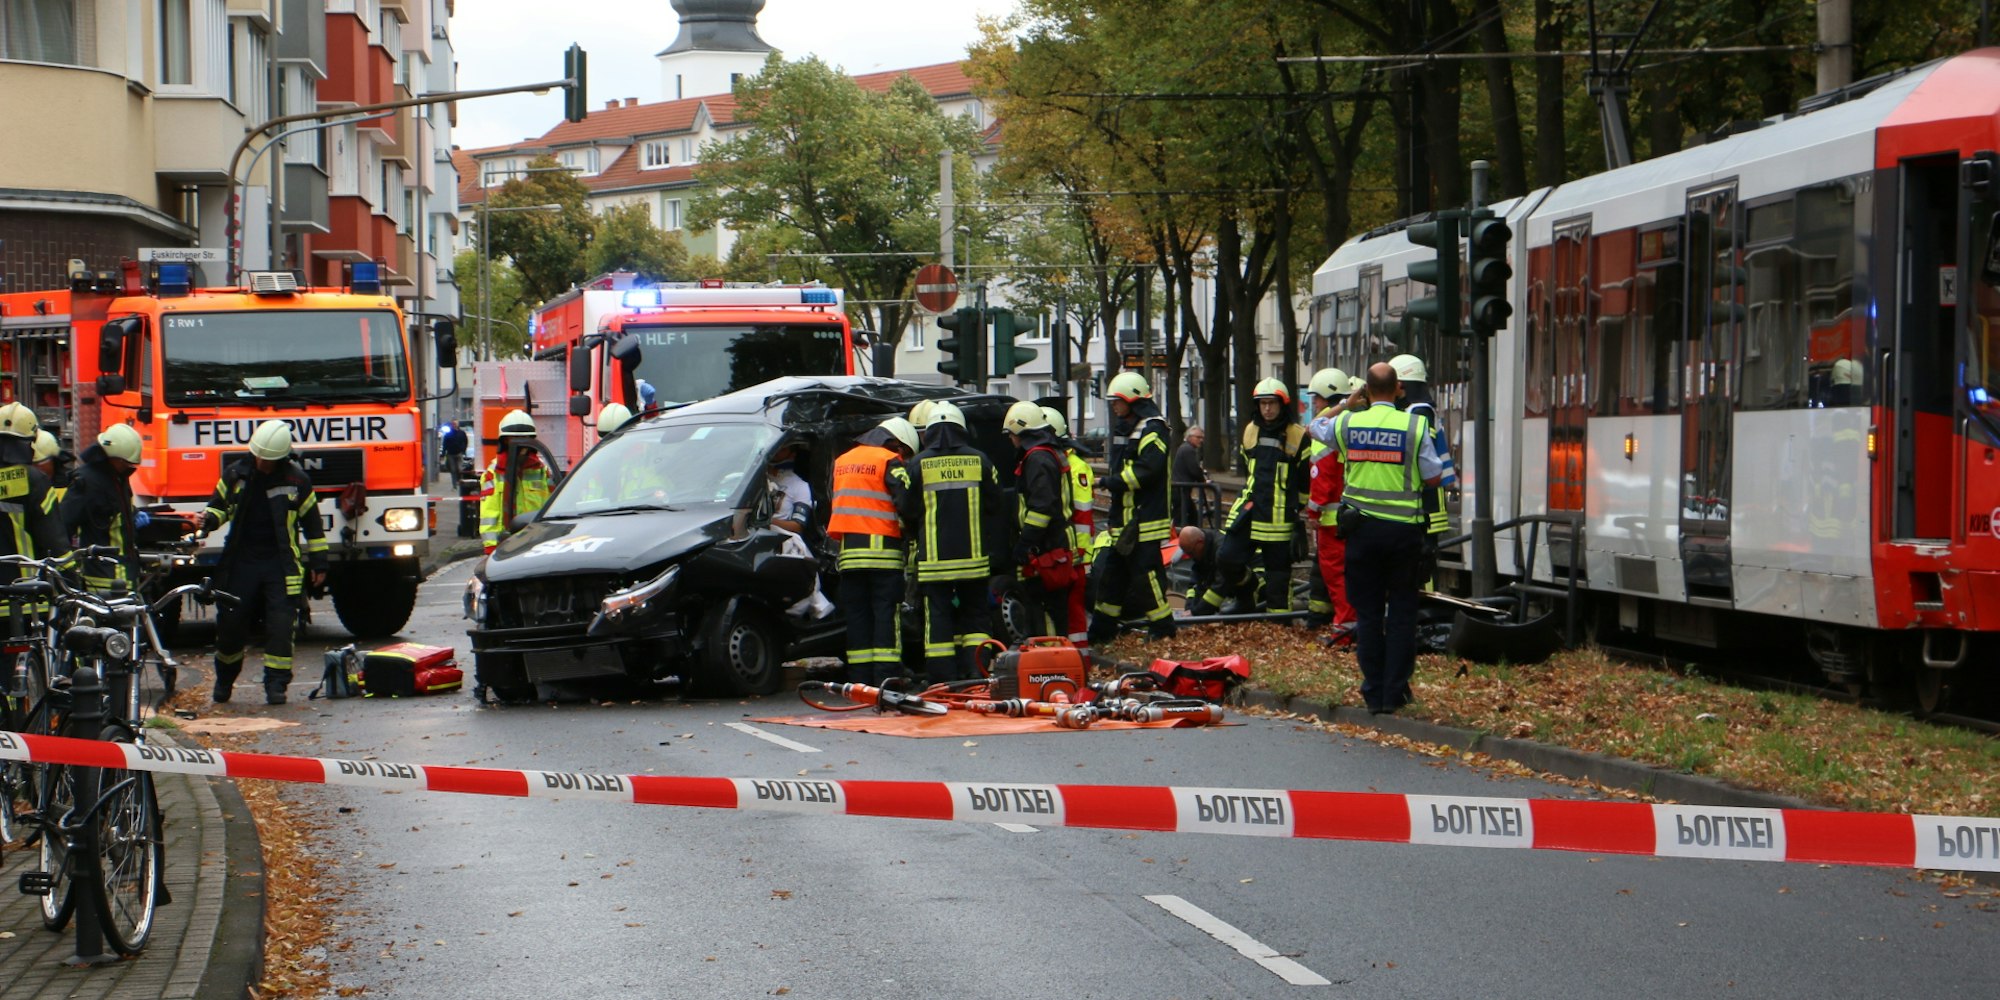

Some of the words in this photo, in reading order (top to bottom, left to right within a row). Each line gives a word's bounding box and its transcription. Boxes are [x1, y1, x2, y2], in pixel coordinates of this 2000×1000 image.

[151, 250, 201, 259] Euskirchener
[203, 250, 216, 259] Str.
[168, 319, 175, 328] 2
[177, 319, 195, 328] RW
[197, 319, 204, 327] 1
[646, 332, 676, 345] HLF
[681, 332, 688, 345] 1
[195, 417, 387, 446] FEURWEHR
[1350, 430, 1402, 447] POLIZEI
[836, 464, 876, 476] FEUERWEHR
[1970, 513, 1991, 532] KVB
